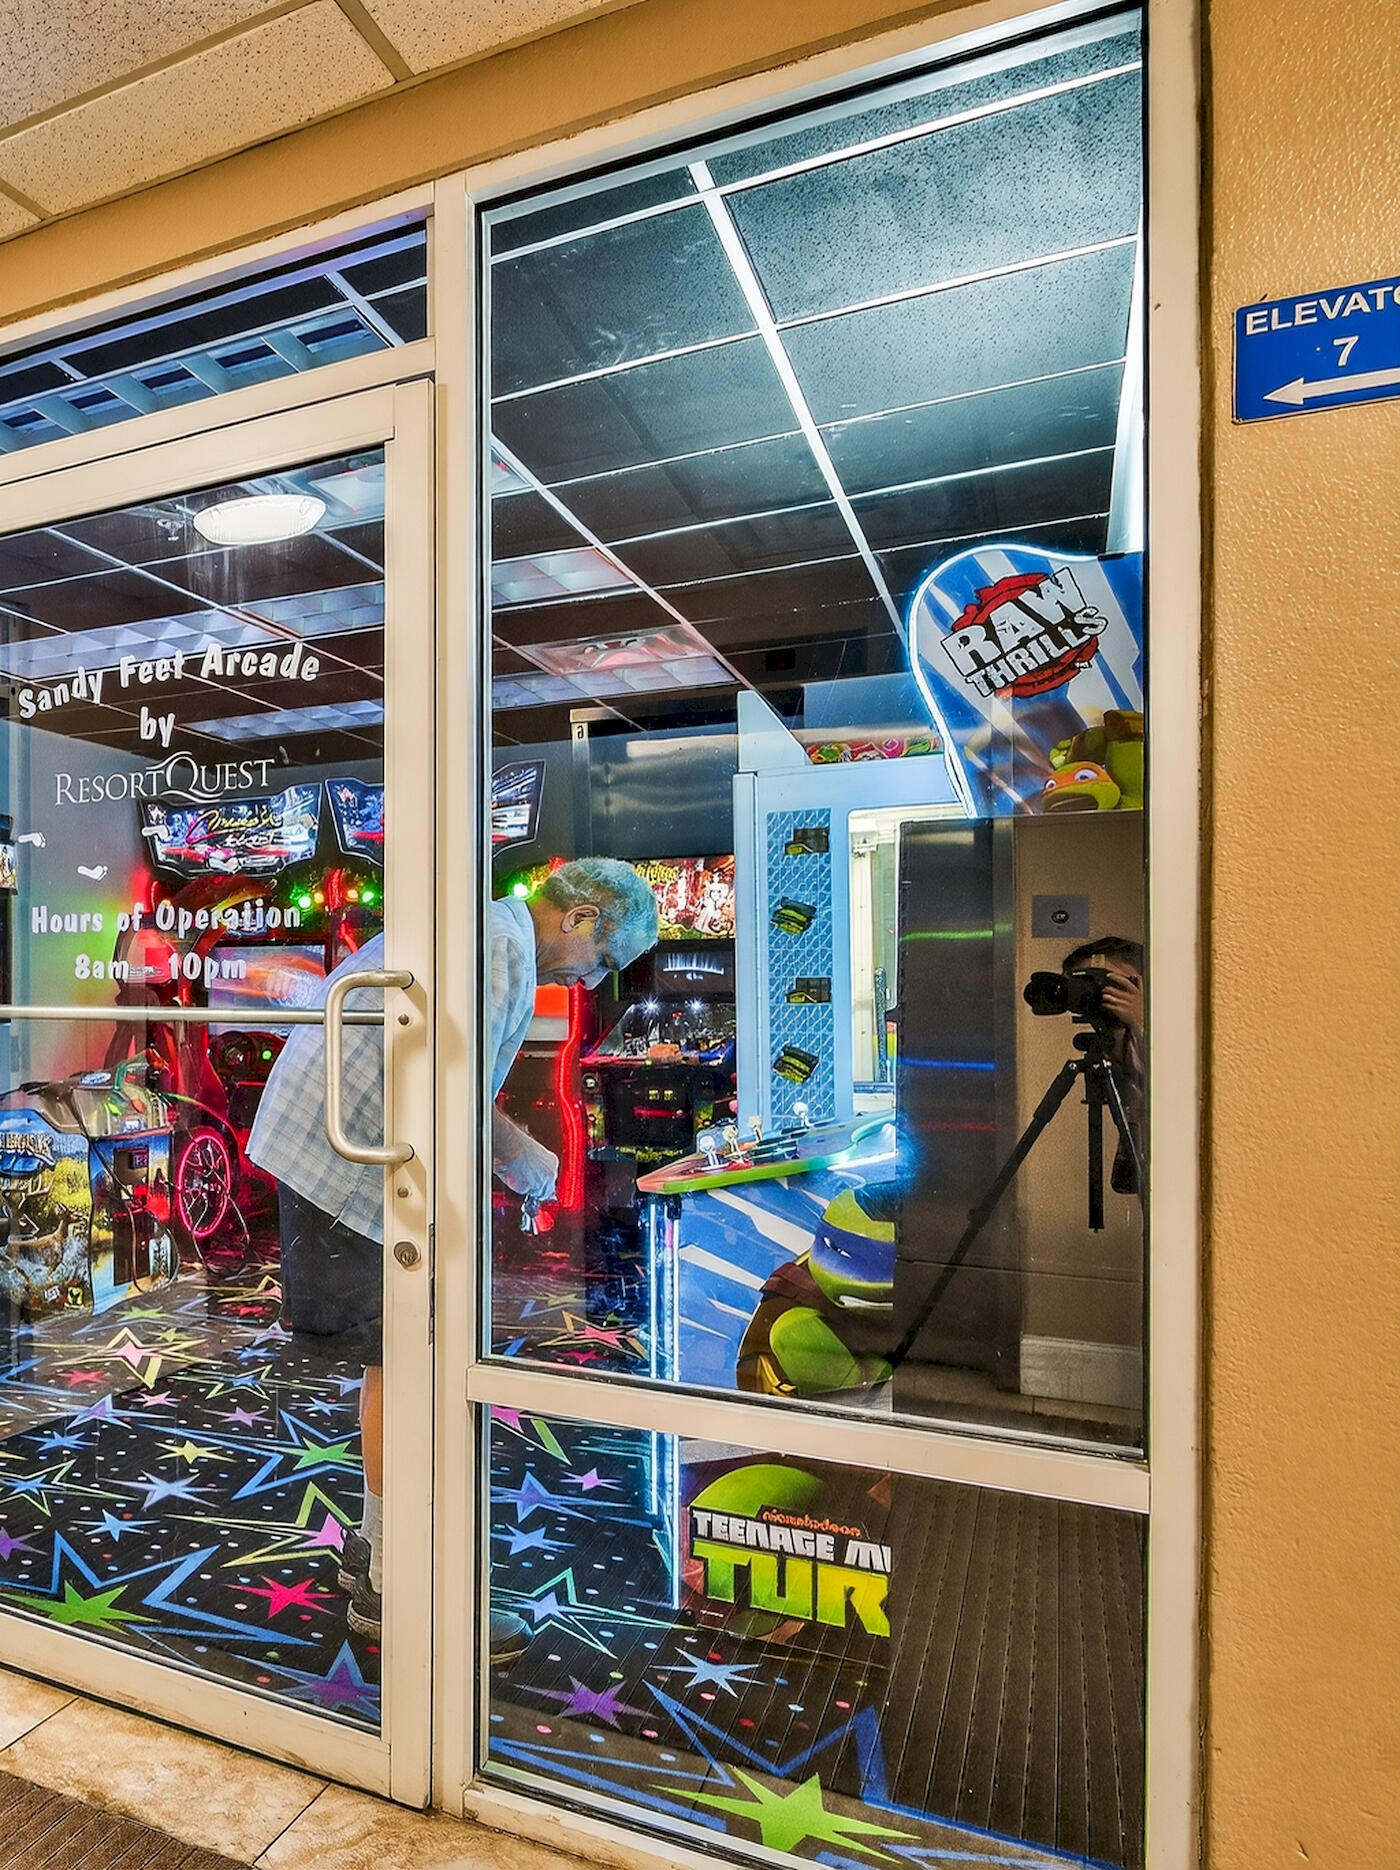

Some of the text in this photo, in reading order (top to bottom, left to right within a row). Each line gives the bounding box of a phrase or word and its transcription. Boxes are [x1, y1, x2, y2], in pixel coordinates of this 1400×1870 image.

[1333, 335, 1360, 367] 7
[940, 566, 1089, 677] RAW
[965, 606, 1109, 698] THRILLS
[18, 642, 320, 719] Sandy Feet Arcade
[140, 706, 176, 748] by
[31, 898, 302, 939] Hours of Operation
[73, 953, 130, 983] 8am
[167, 951, 248, 989] 10pm
[692, 1509, 836, 1562] TEENAGE
[692, 1538, 892, 1638] TUR
